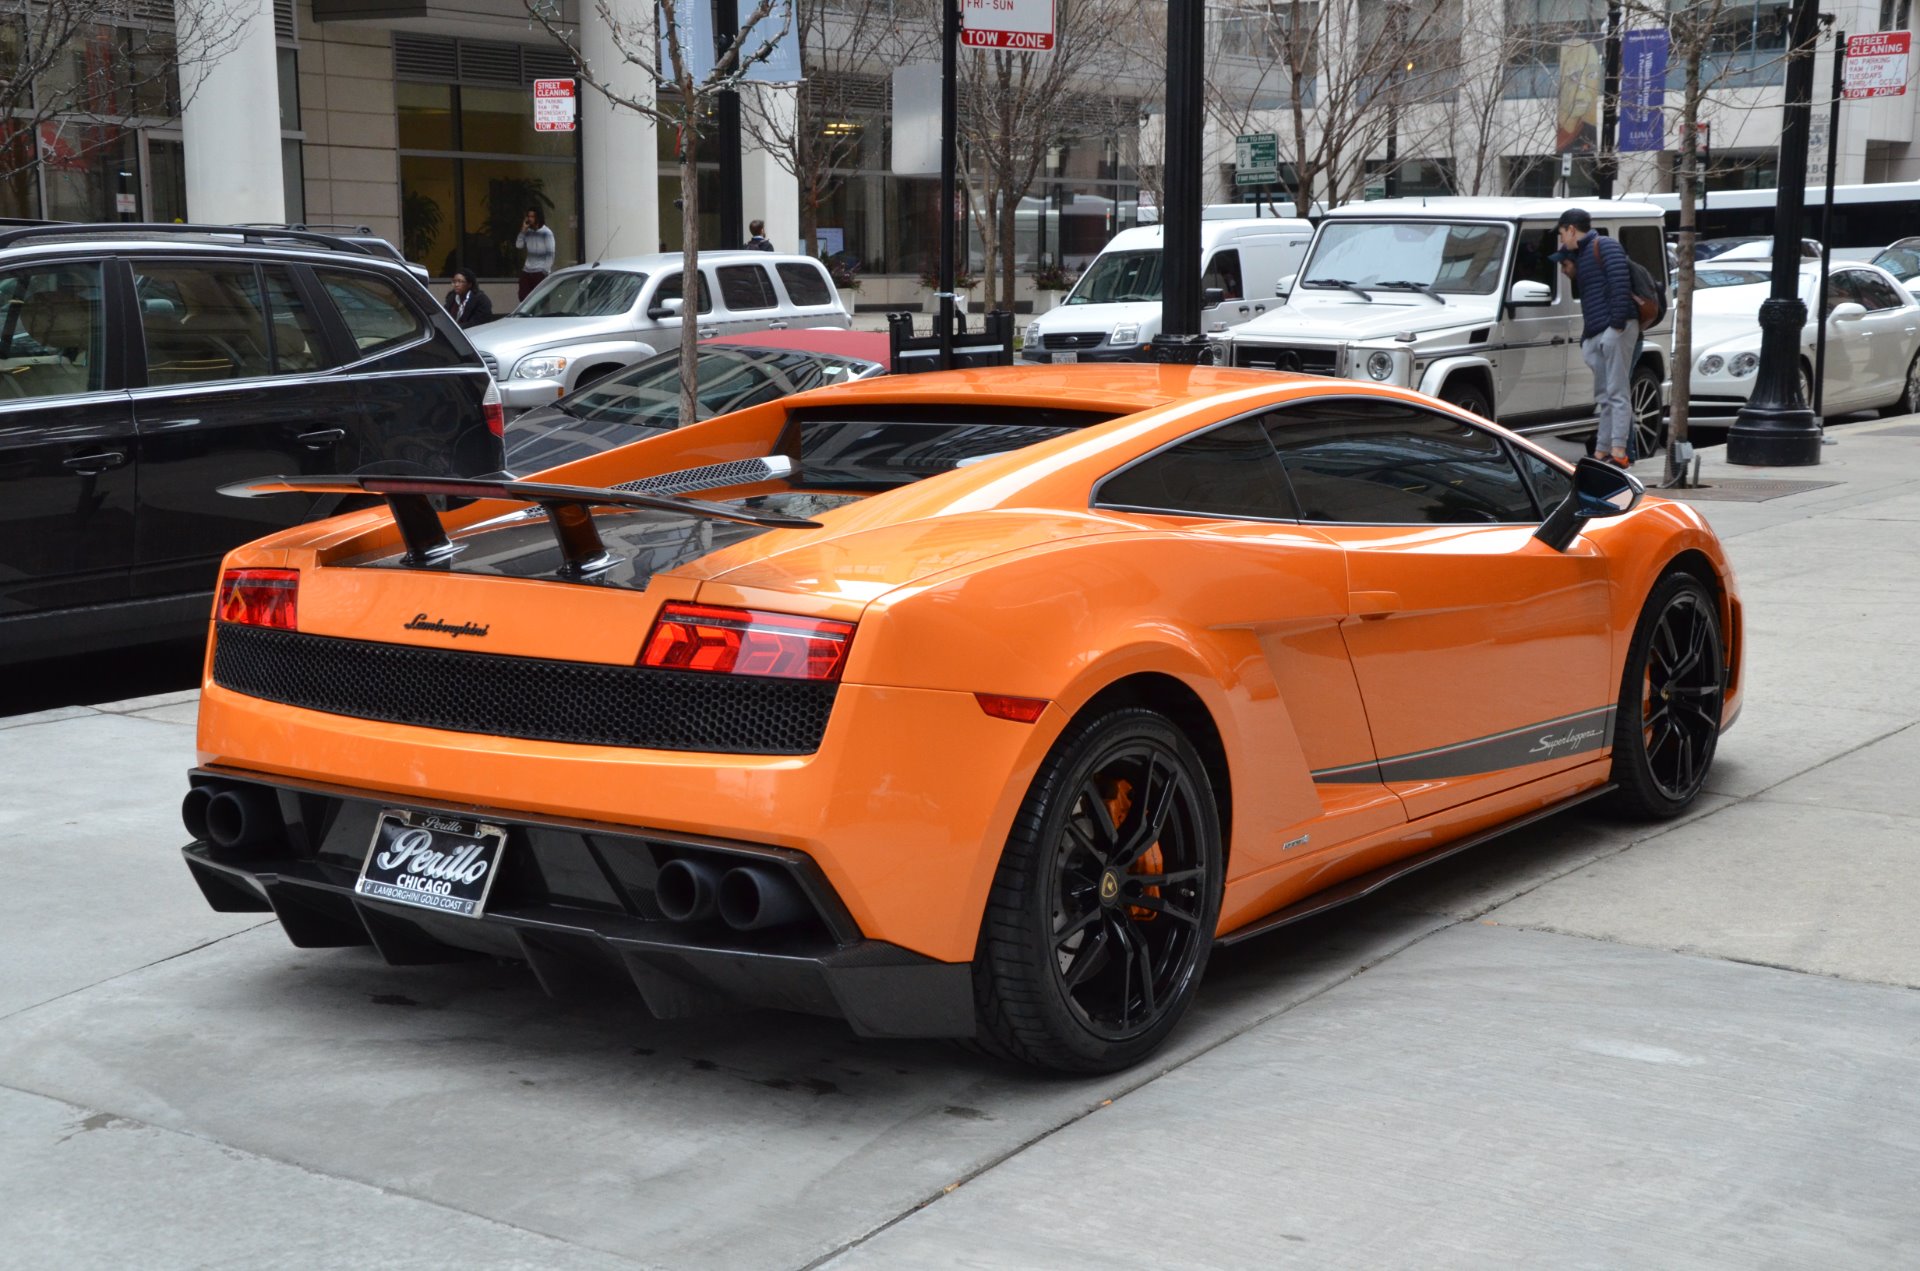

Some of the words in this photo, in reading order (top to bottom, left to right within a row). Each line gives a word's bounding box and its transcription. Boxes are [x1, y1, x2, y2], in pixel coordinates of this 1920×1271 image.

[966, 30, 998, 45] TOW
[1006, 32, 1046, 48] ZONE
[1852, 36, 1889, 46] STREET
[1850, 44, 1903, 55] CLEANING
[1846, 89, 1868, 98] TOW
[1874, 88, 1902, 96] ZONE
[404, 613, 490, 638] Lamborghini
[422, 816, 462, 832] Perillo
[376, 828, 488, 885] Perillo
[396, 874, 452, 896] CHICAGO
[374, 886, 420, 904] LAMBORGHINI
[420, 895, 440, 906] GOLD
[440, 899, 462, 910] COAST
